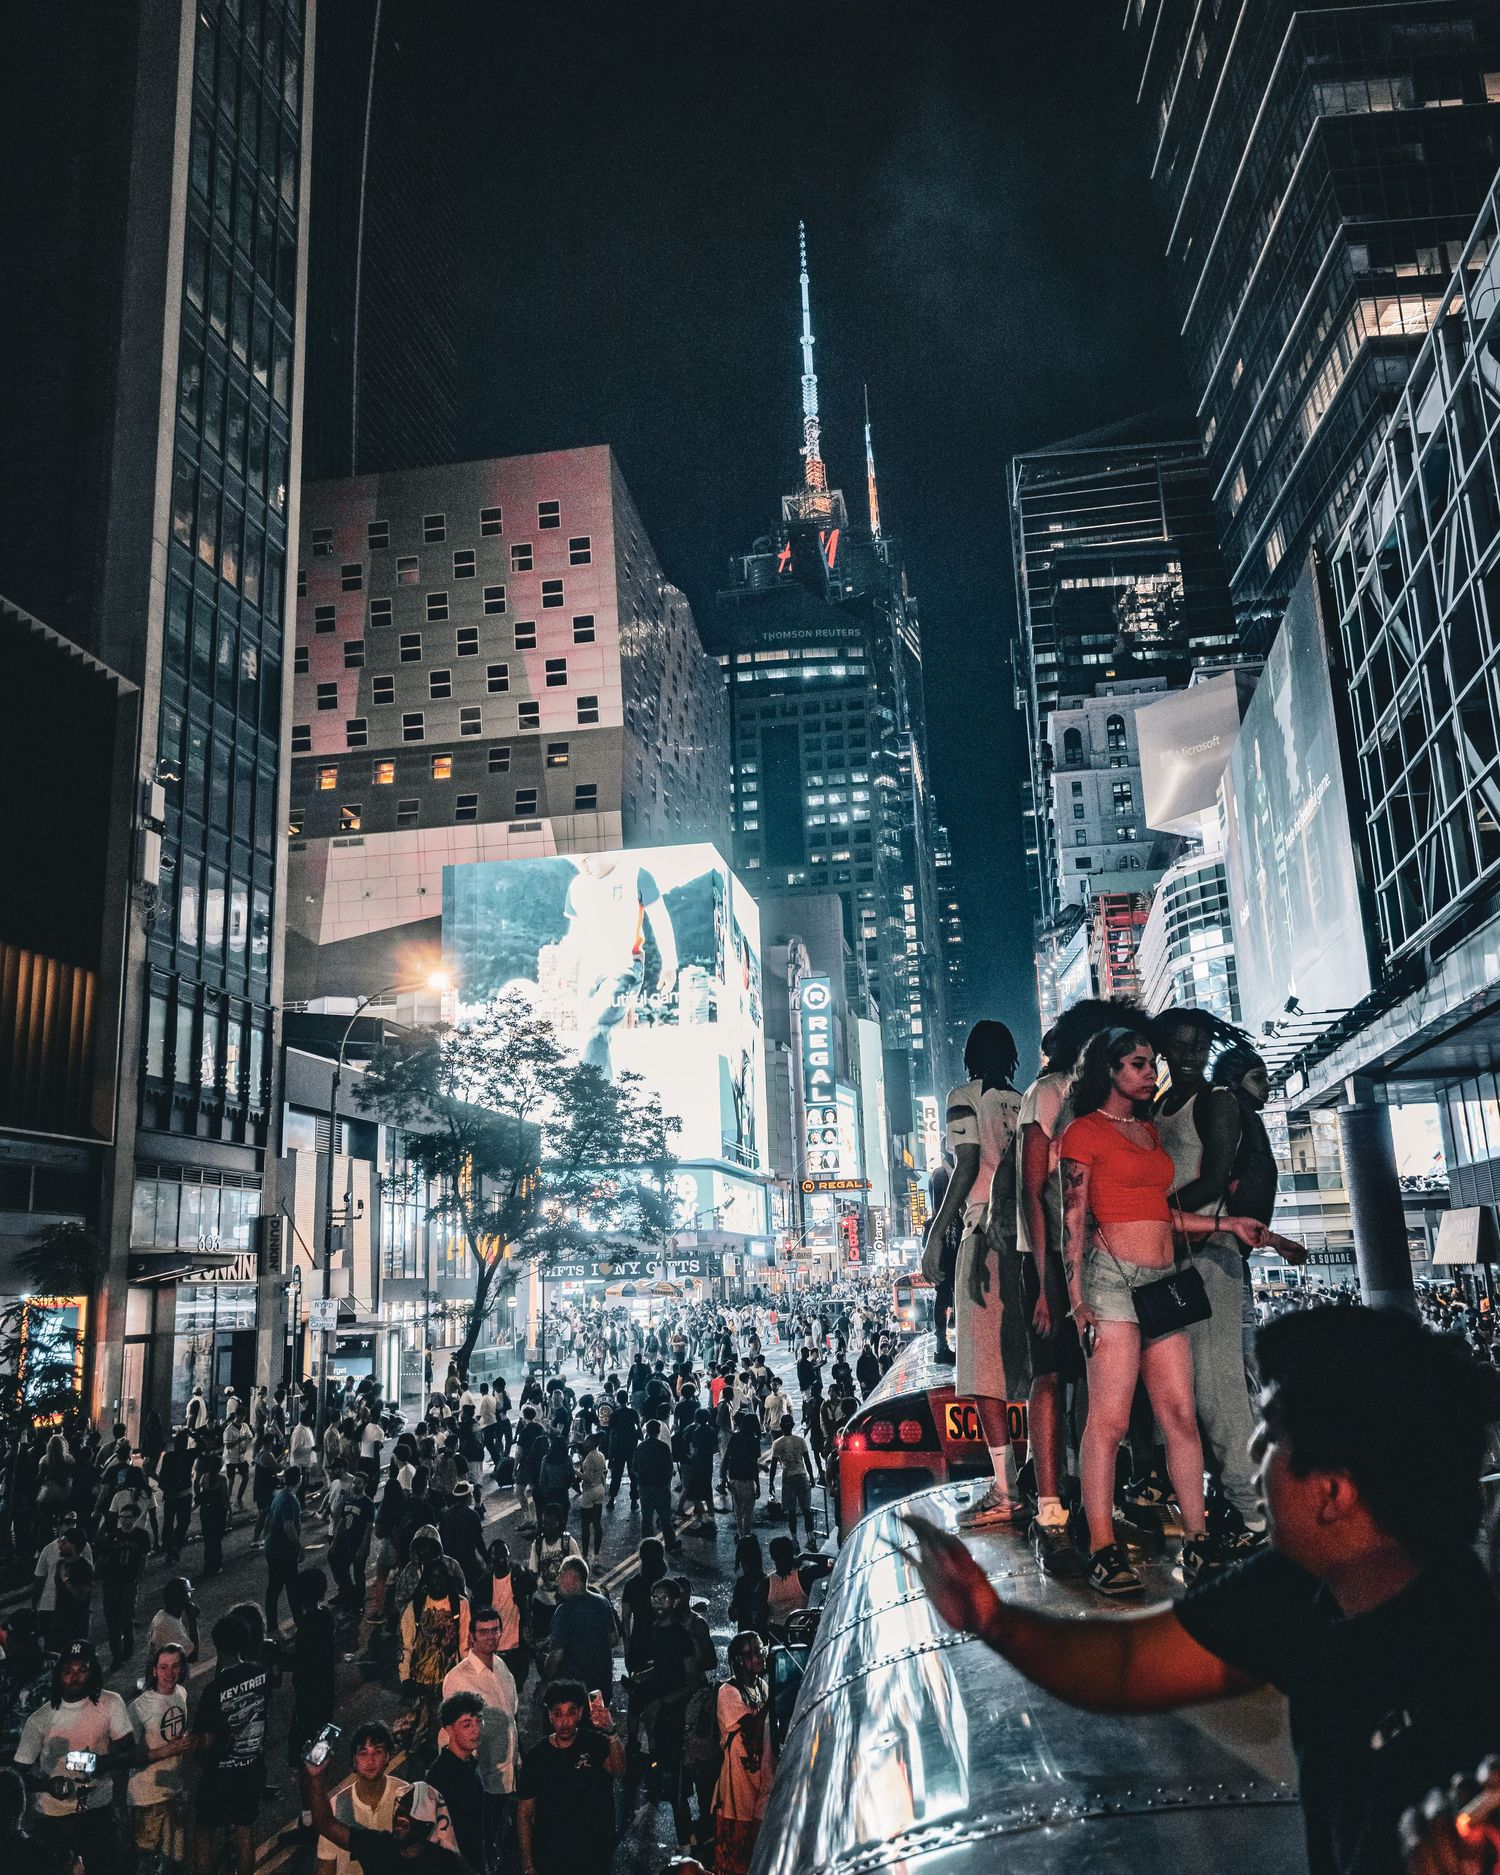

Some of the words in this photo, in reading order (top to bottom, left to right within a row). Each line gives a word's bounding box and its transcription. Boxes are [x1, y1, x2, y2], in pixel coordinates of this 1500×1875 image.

[762, 629, 812, 640] THOMSON
[815, 628, 861, 637] REUTERS
[1178, 735, 1221, 760] Microsoft
[809, 1016, 831, 1101] REGAL
[819, 1181, 863, 1189] REGAL
[874, 1210, 884, 1241] target
[269, 1219, 281, 1272] DUNKIN'
[1319, 1252, 1351, 1264] SQUARE
[314, 1301, 334, 1309] NYPD
[949, 1405, 1029, 1440] SCO
[219, 1685, 240, 1703] KEY
[239, 1673, 267, 1692] STREET
